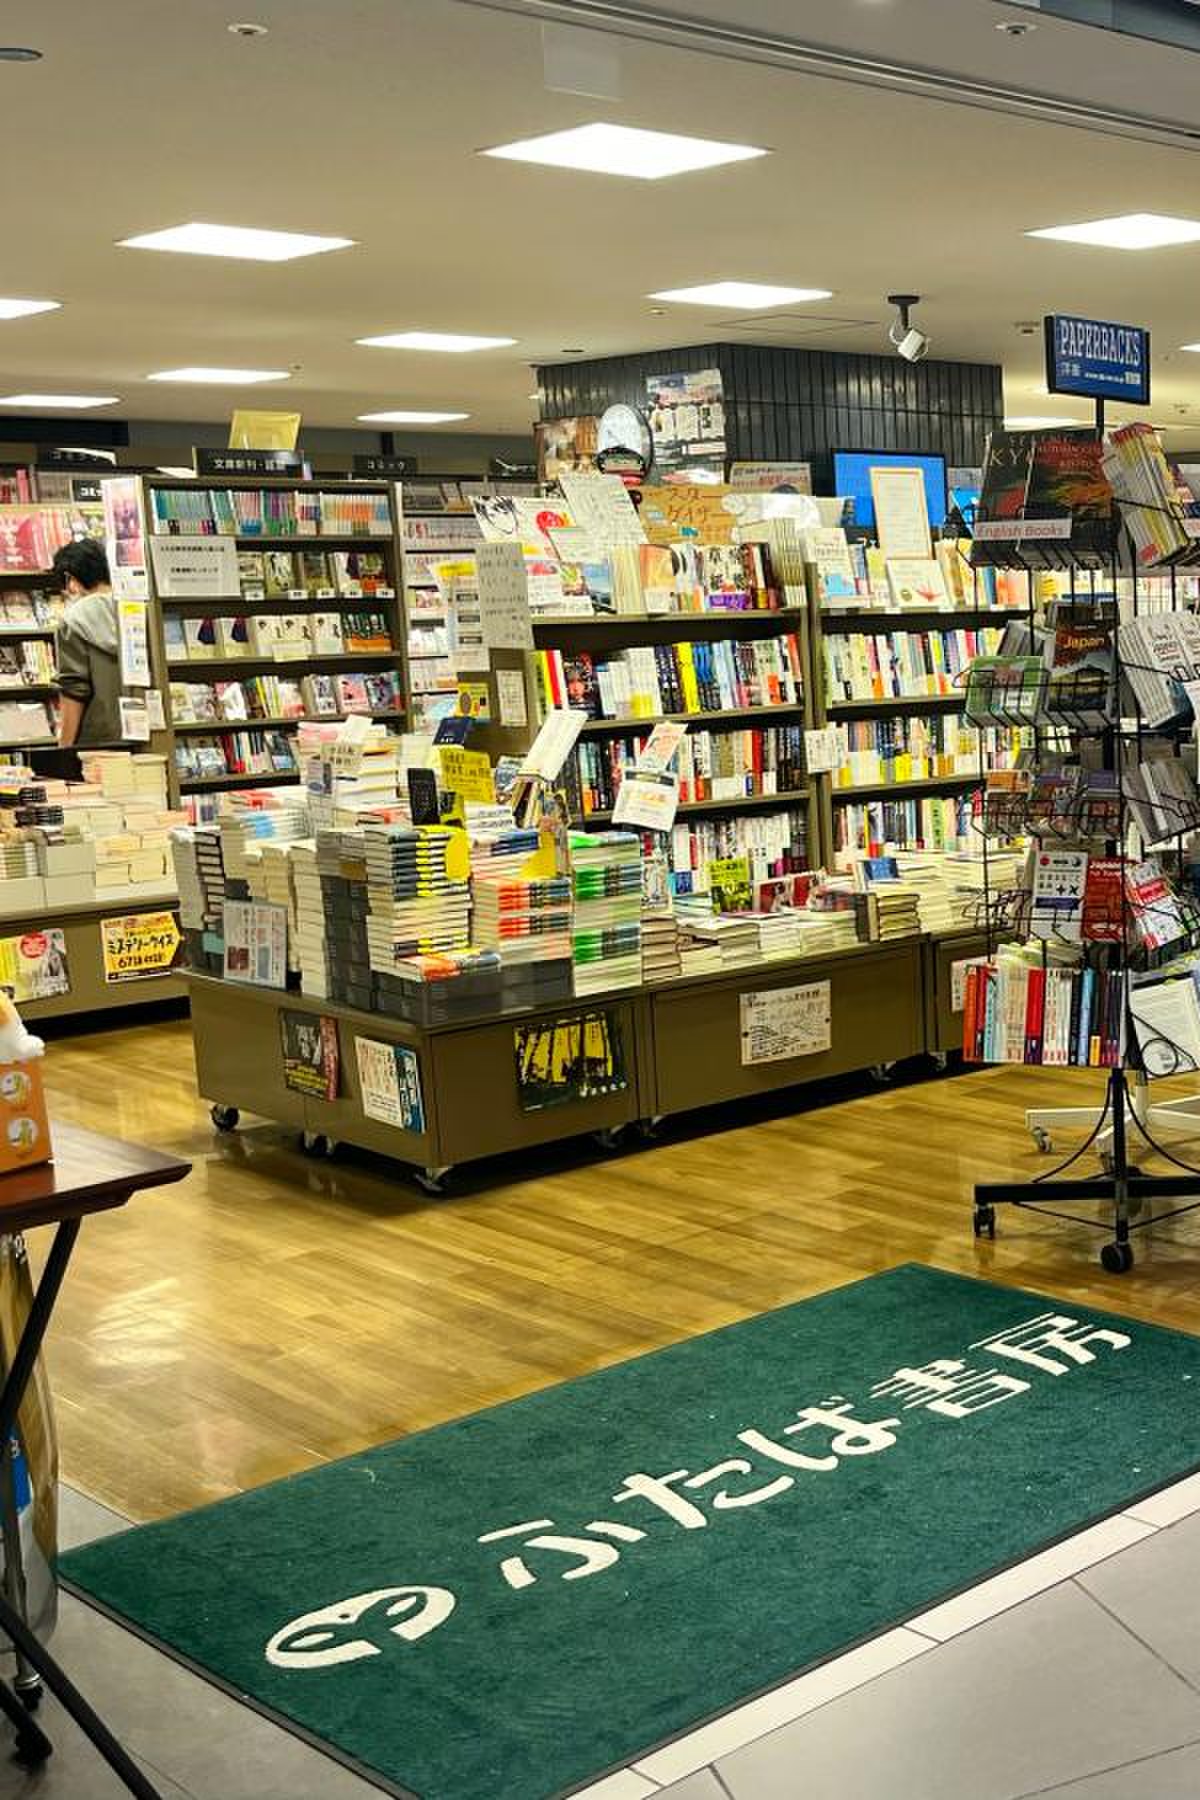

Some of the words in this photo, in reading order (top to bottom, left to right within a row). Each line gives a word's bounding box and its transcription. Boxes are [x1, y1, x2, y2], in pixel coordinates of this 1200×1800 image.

[1060, 319, 1140, 367] PAPERBACKS
[977, 524, 1020, 543] English
[1023, 520, 1066, 538] Books
[1066, 636, 1104, 652] Japan
[478, 1314, 1132, 1589] ふたば書房
